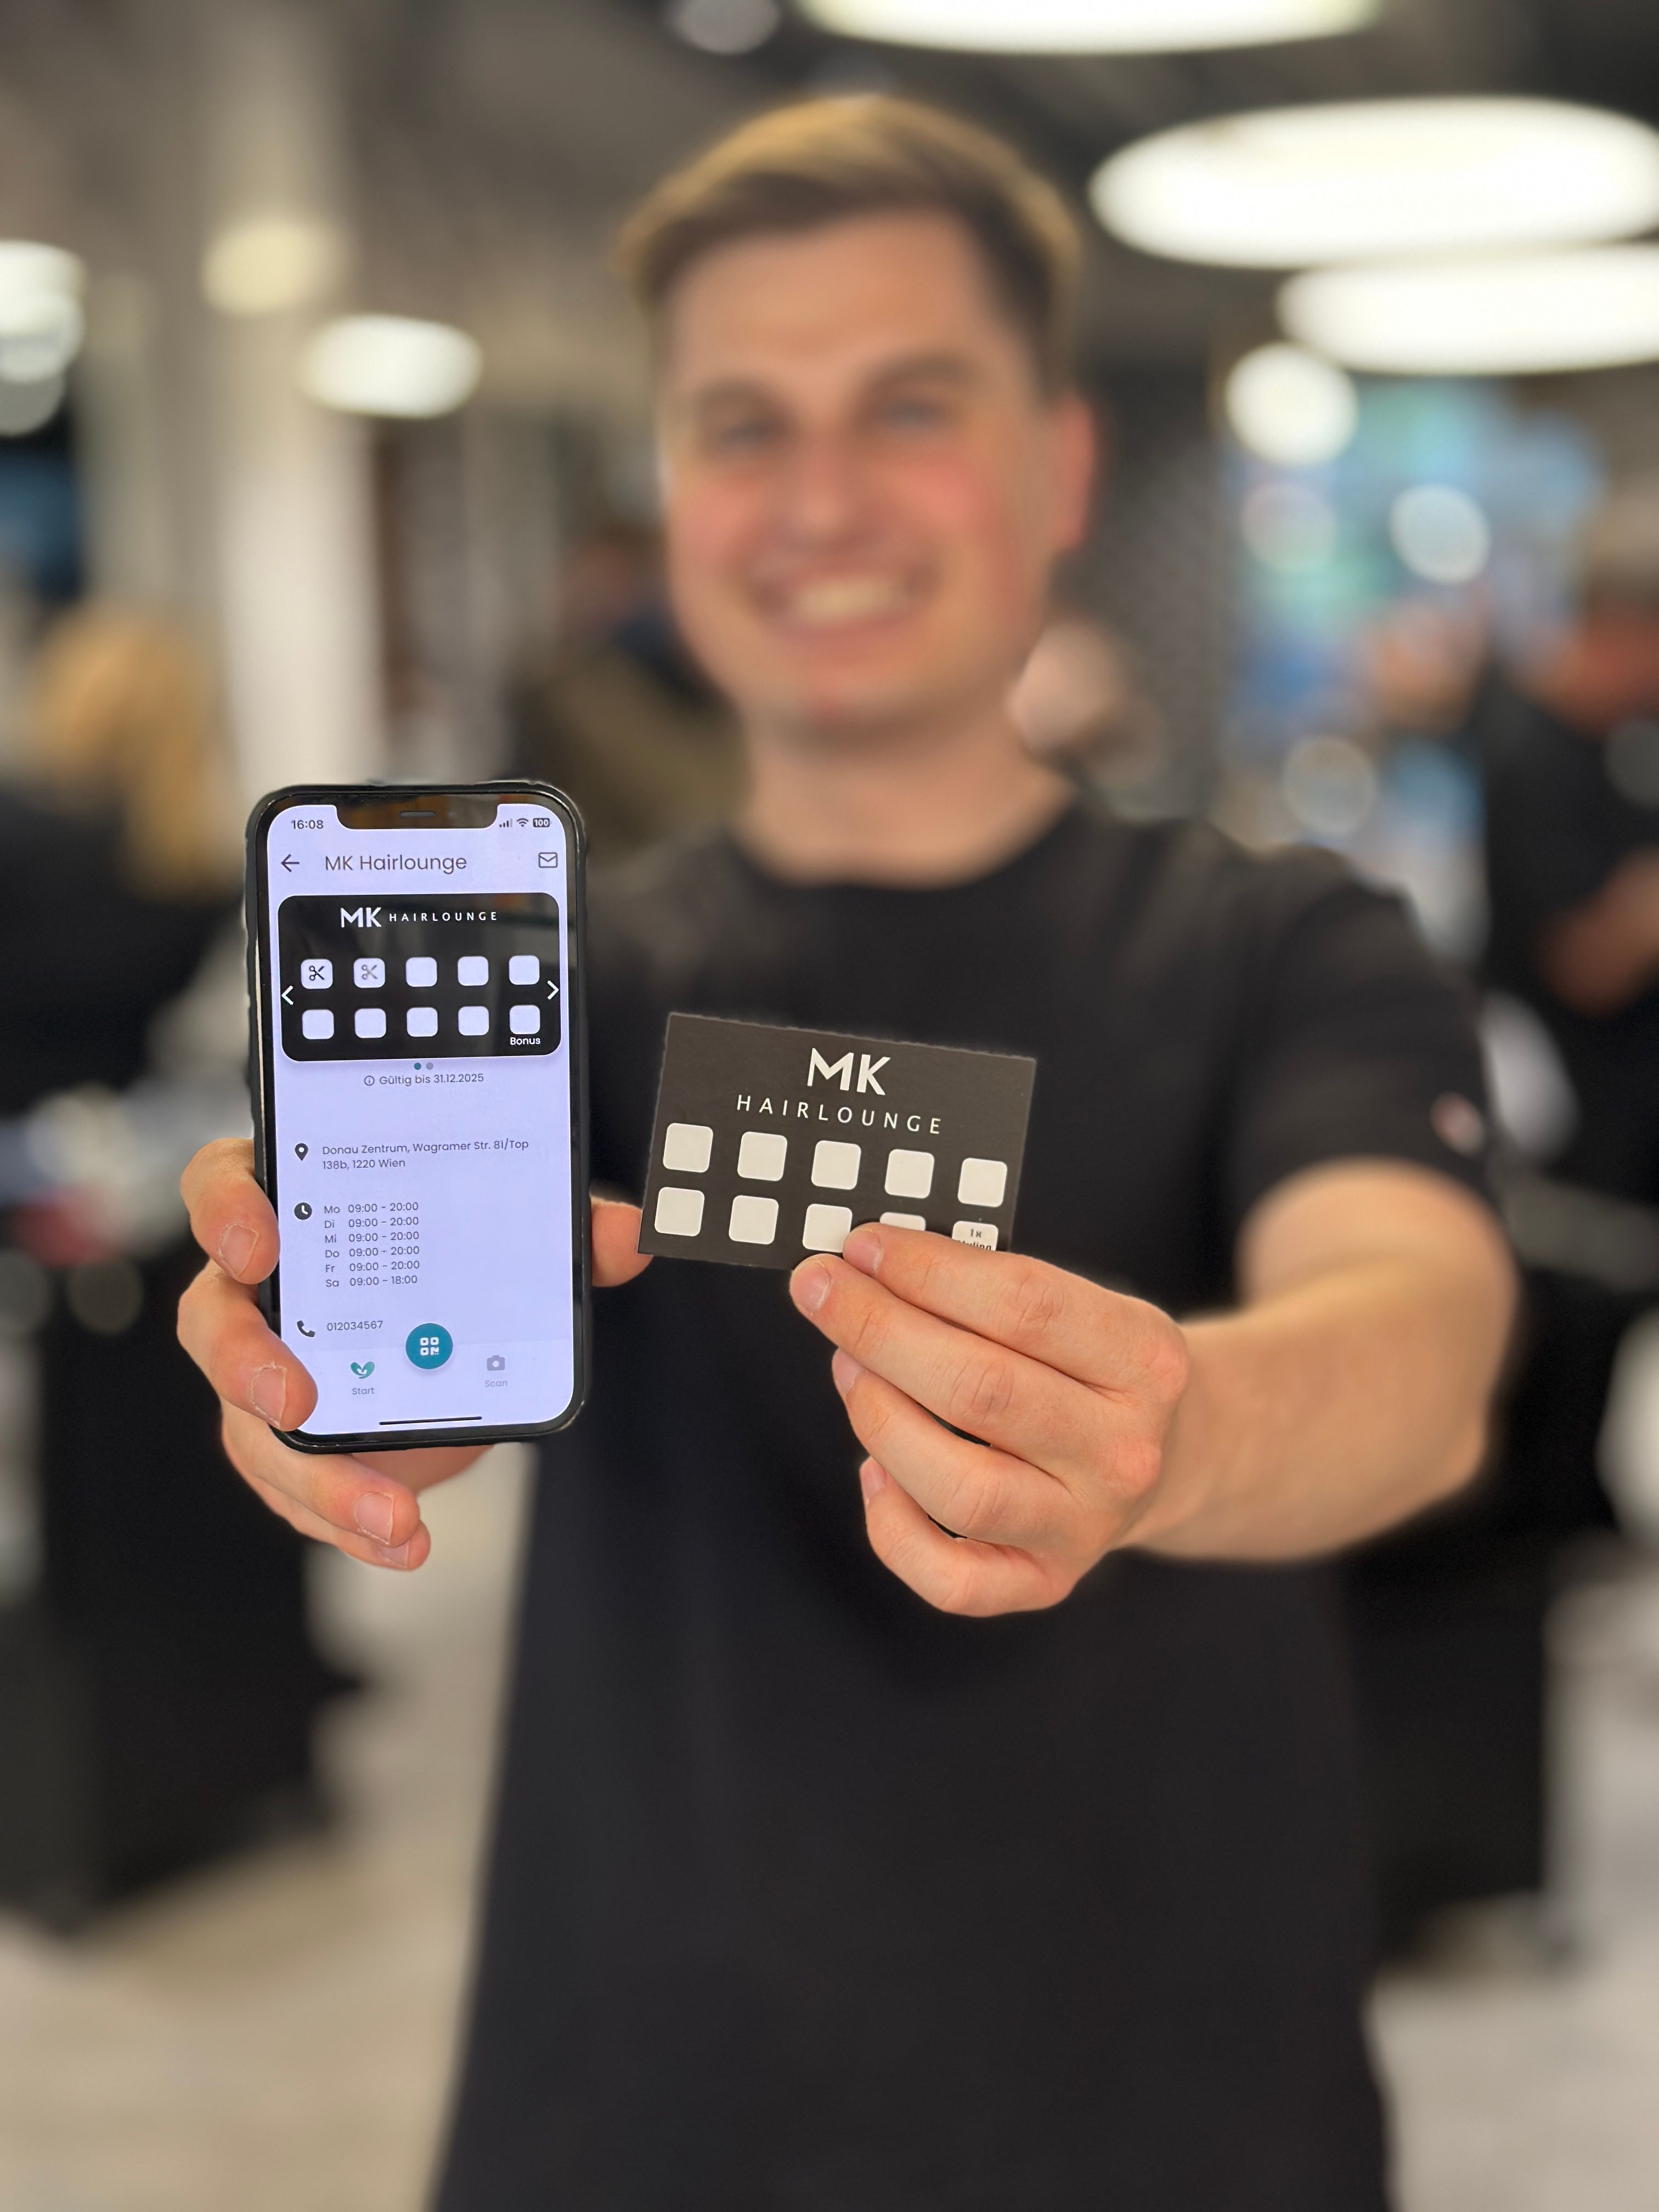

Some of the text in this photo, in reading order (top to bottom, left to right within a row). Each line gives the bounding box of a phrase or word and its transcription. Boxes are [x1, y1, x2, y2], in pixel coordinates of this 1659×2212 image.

[291, 820, 324, 830] 16:08
[325, 854, 467, 875] MK Hairlounge
[341, 907, 497, 928] MK HAIRLOUNGE
[510, 1036, 541, 1046] Bonus
[807, 1047, 891, 1096] MK
[379, 1073, 484, 1087] Gültig bis 31.12.2025
[737, 1094, 941, 1134] HAIRLOUNGE
[322, 1138, 529, 1155] Donau Zentrum, Wagramer Str. 81/Top
[352, 1159, 376, 1169] 1220
[378, 1158, 405, 1168] Wien
[324, 1205, 340, 1214] Mo
[348, 1203, 377, 1213] 09:00
[390, 1201, 419, 1211] 20:00
[324, 1220, 335, 1229] Di
[348, 1218, 378, 1228] 09:00
[390, 1216, 419, 1226] 20:00
[325, 1234, 337, 1243] Mi
[348, 1233, 379, 1243] 09:00
[390, 1231, 419, 1241] 20:00
[325, 1250, 340, 1258] Do
[349, 1247, 379, 1257] 09:00
[391, 1245, 420, 1256] 20:00
[325, 1264, 335, 1273] Fr
[349, 1262, 379, 1272] 09:00
[391, 1260, 420, 1270] 20:00
[325, 1279, 340, 1288] Sa
[349, 1277, 379, 1286] 09:00
[391, 1275, 417, 1285] 18:00
[326, 1320, 383, 1331] 012034567
[352, 1387, 375, 1395] Start
